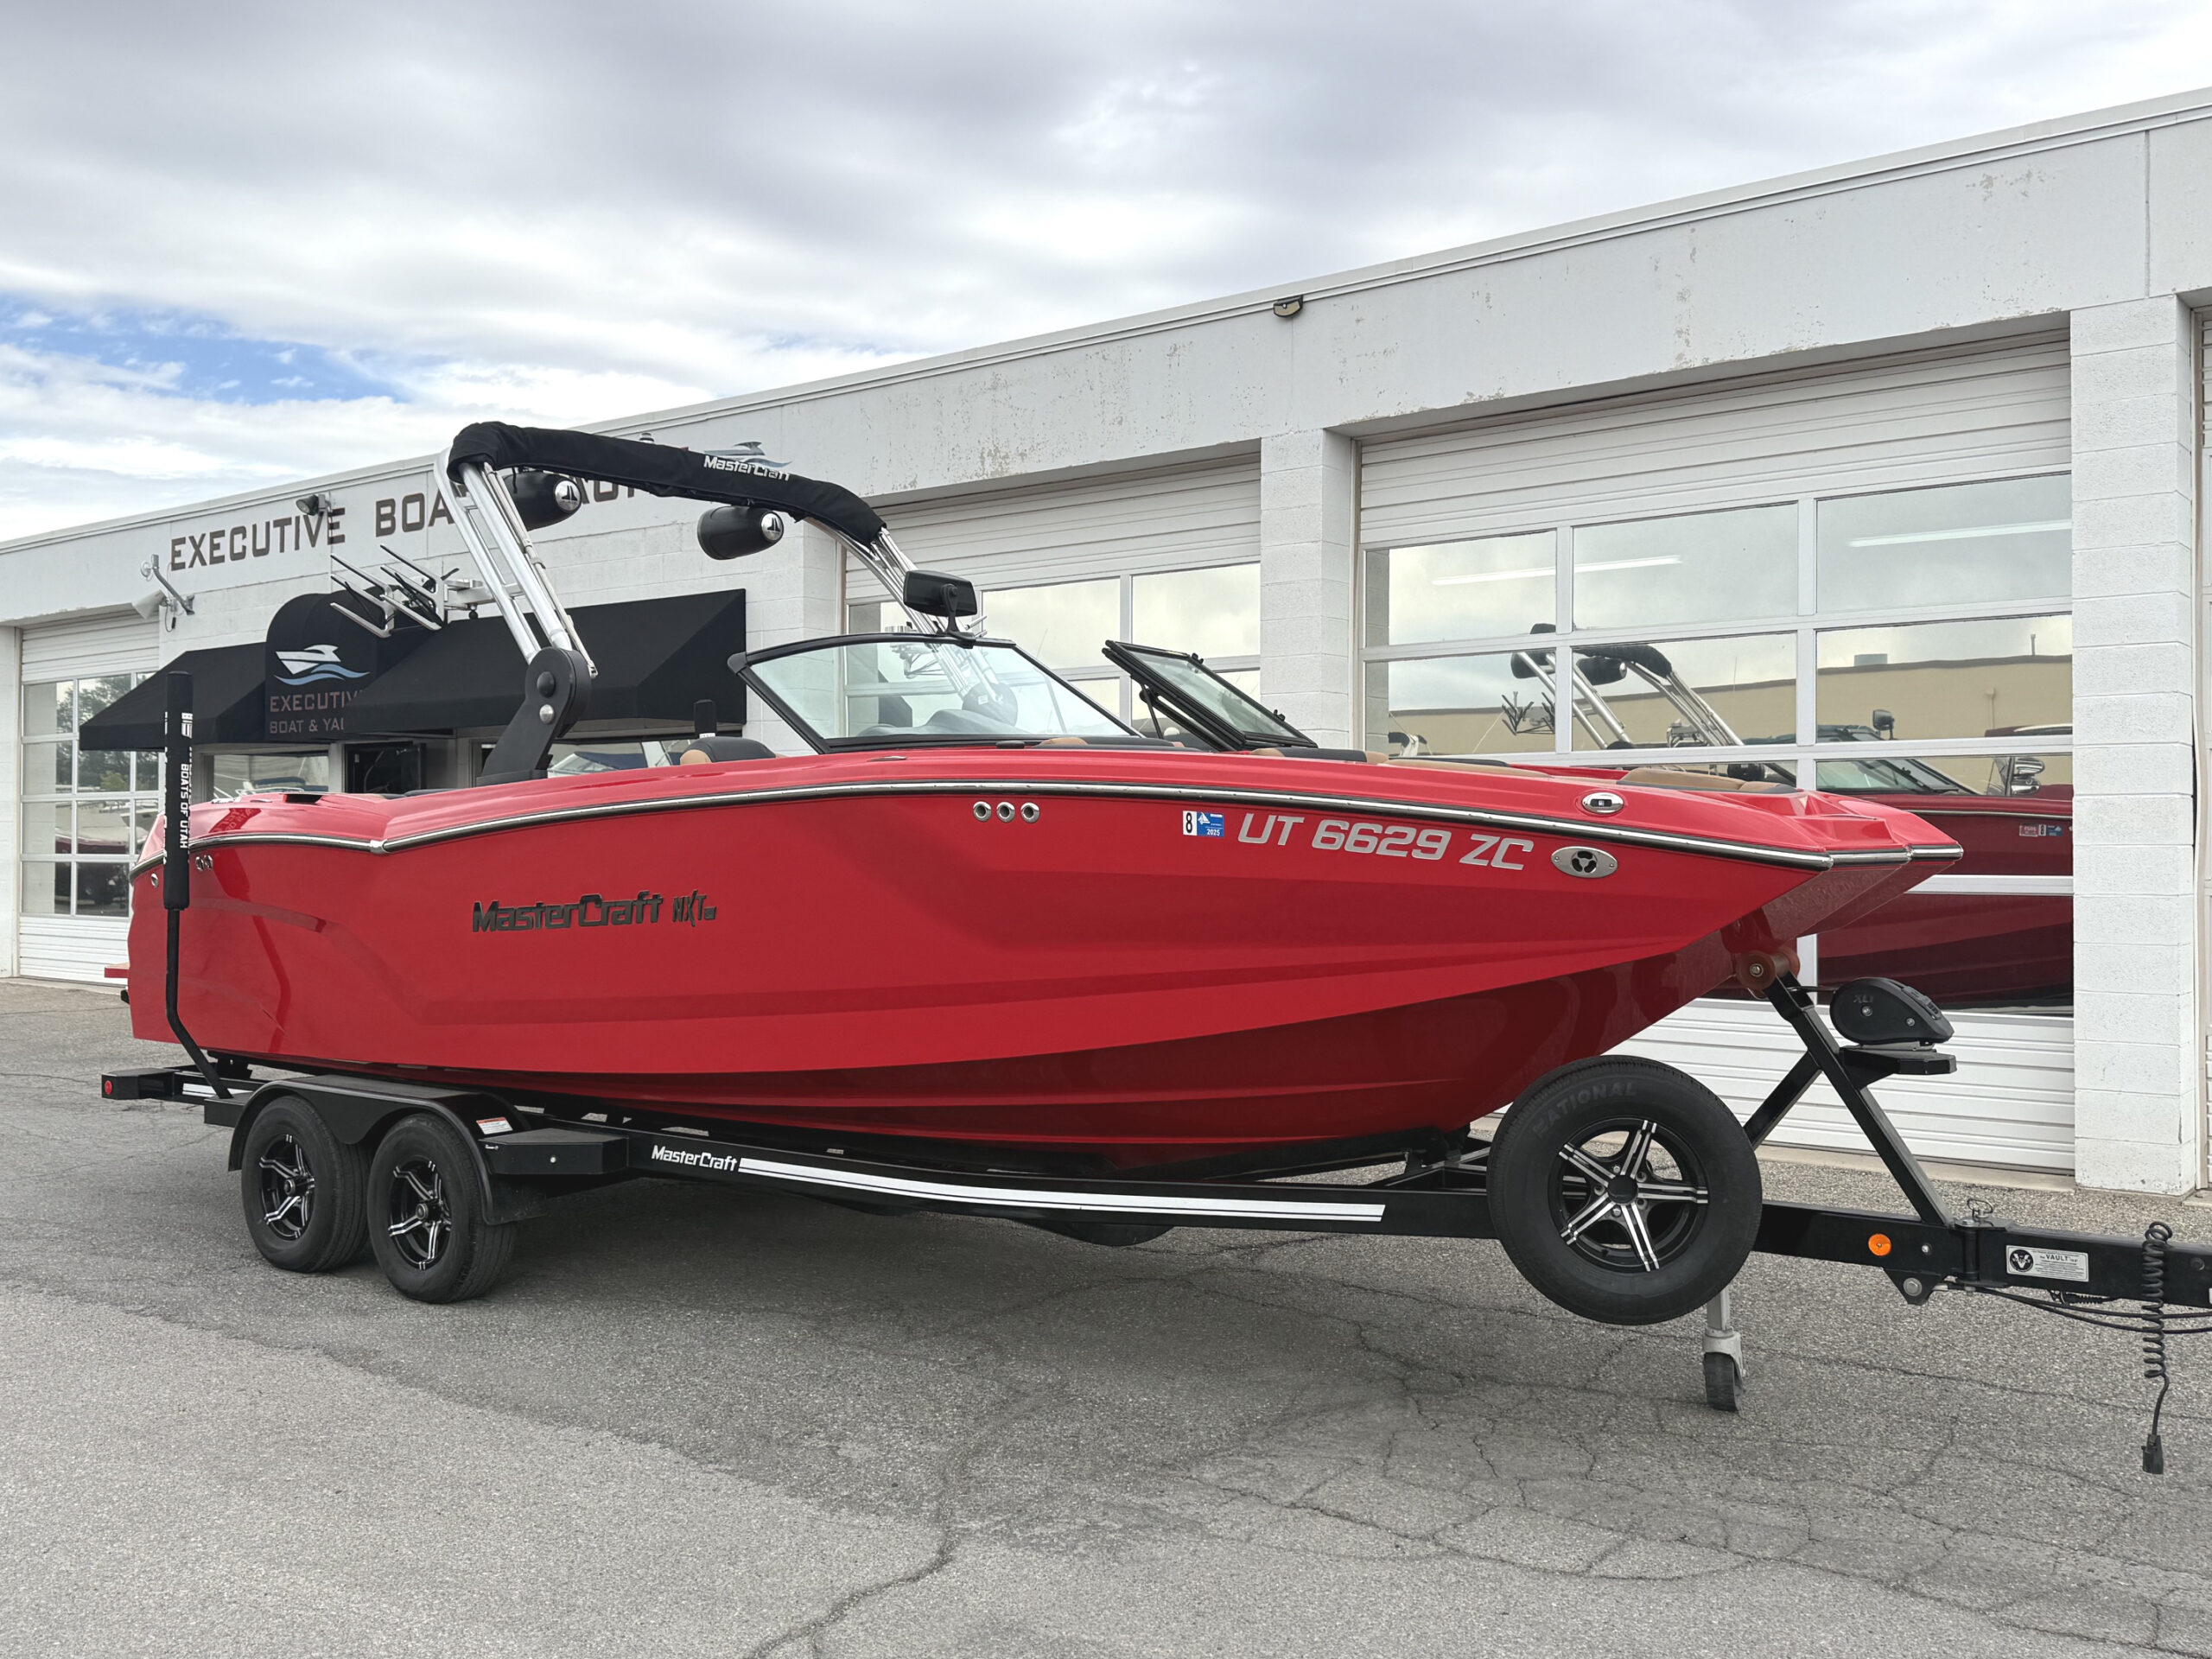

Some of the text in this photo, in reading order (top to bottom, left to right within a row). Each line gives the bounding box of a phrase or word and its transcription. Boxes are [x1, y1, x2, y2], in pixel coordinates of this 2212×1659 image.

[170, 485, 469, 572] EXECUTIVE BOA
[270, 690, 363, 713] EXECUTIV
[270, 720, 304, 734] BOAT
[308, 719, 318, 732] &
[179, 763, 189, 849] BOATS OF UTAH
[1185, 812, 1193, 834] 8
[1206, 828, 1221, 836] 2025
[1237, 812, 1535, 871] UT 6629 ZC
[472, 890, 664, 932] MasterCraft
[651, 1144, 738, 1172] MasterCraft
